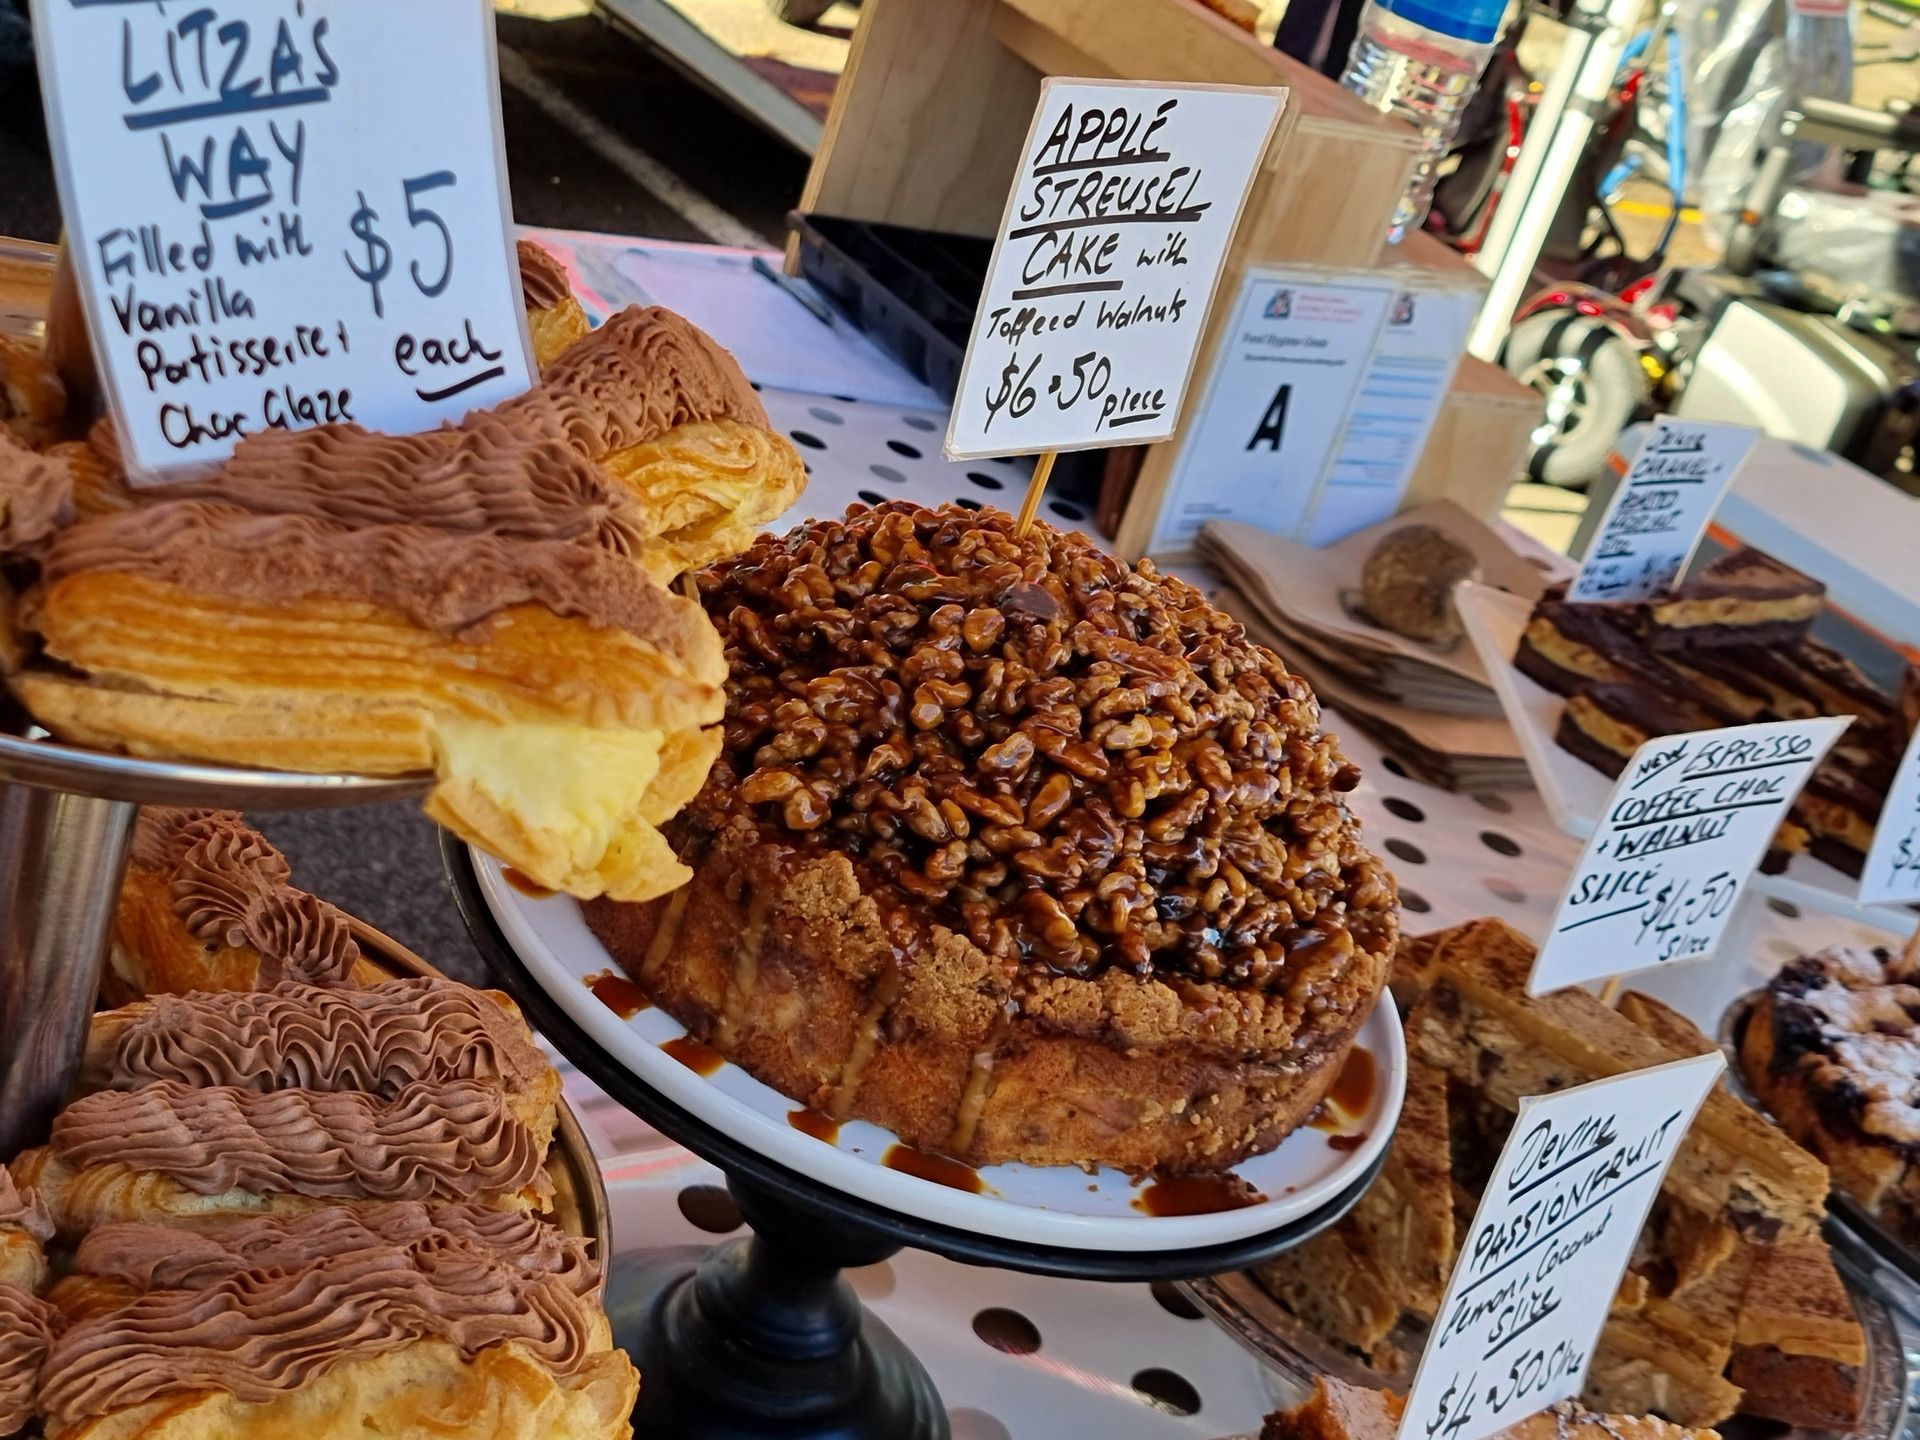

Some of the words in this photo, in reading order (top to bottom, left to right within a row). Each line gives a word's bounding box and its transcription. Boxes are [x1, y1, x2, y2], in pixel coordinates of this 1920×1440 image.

[161, 119, 305, 205] WAY
[1033, 98, 1178, 168] APPLE
[1020, 166, 1213, 223] STREUSEL
[98, 221, 214, 288] Filled
[344, 170, 457, 318] $5
[1021, 230, 1121, 286] CAKE
[1136, 231, 1188, 269] with
[110, 277, 255, 337] Vanilla
[986, 300, 1086, 345] Toffeed
[1096, 288, 1188, 330] Walnuts
[394, 319, 502, 376] each
[263, 384, 354, 431] Glaze
[984, 351, 1112, 434] $6.50
[1094, 387, 1167, 433] piece
[1245, 383, 1293, 452] A
[1635, 740, 1690, 779] NEW
[1681, 735, 1812, 775] ESPRESSO
[1611, 786, 1704, 824] COFFEE
[1714, 776, 1787, 805] CHOC
[1612, 811, 1739, 858] WALNUT
[1571, 863, 1663, 906] SLICE
[1509, 1113, 1618, 1191] Devine
[1470, 1109, 1682, 1274] PASSIONFRUIT
